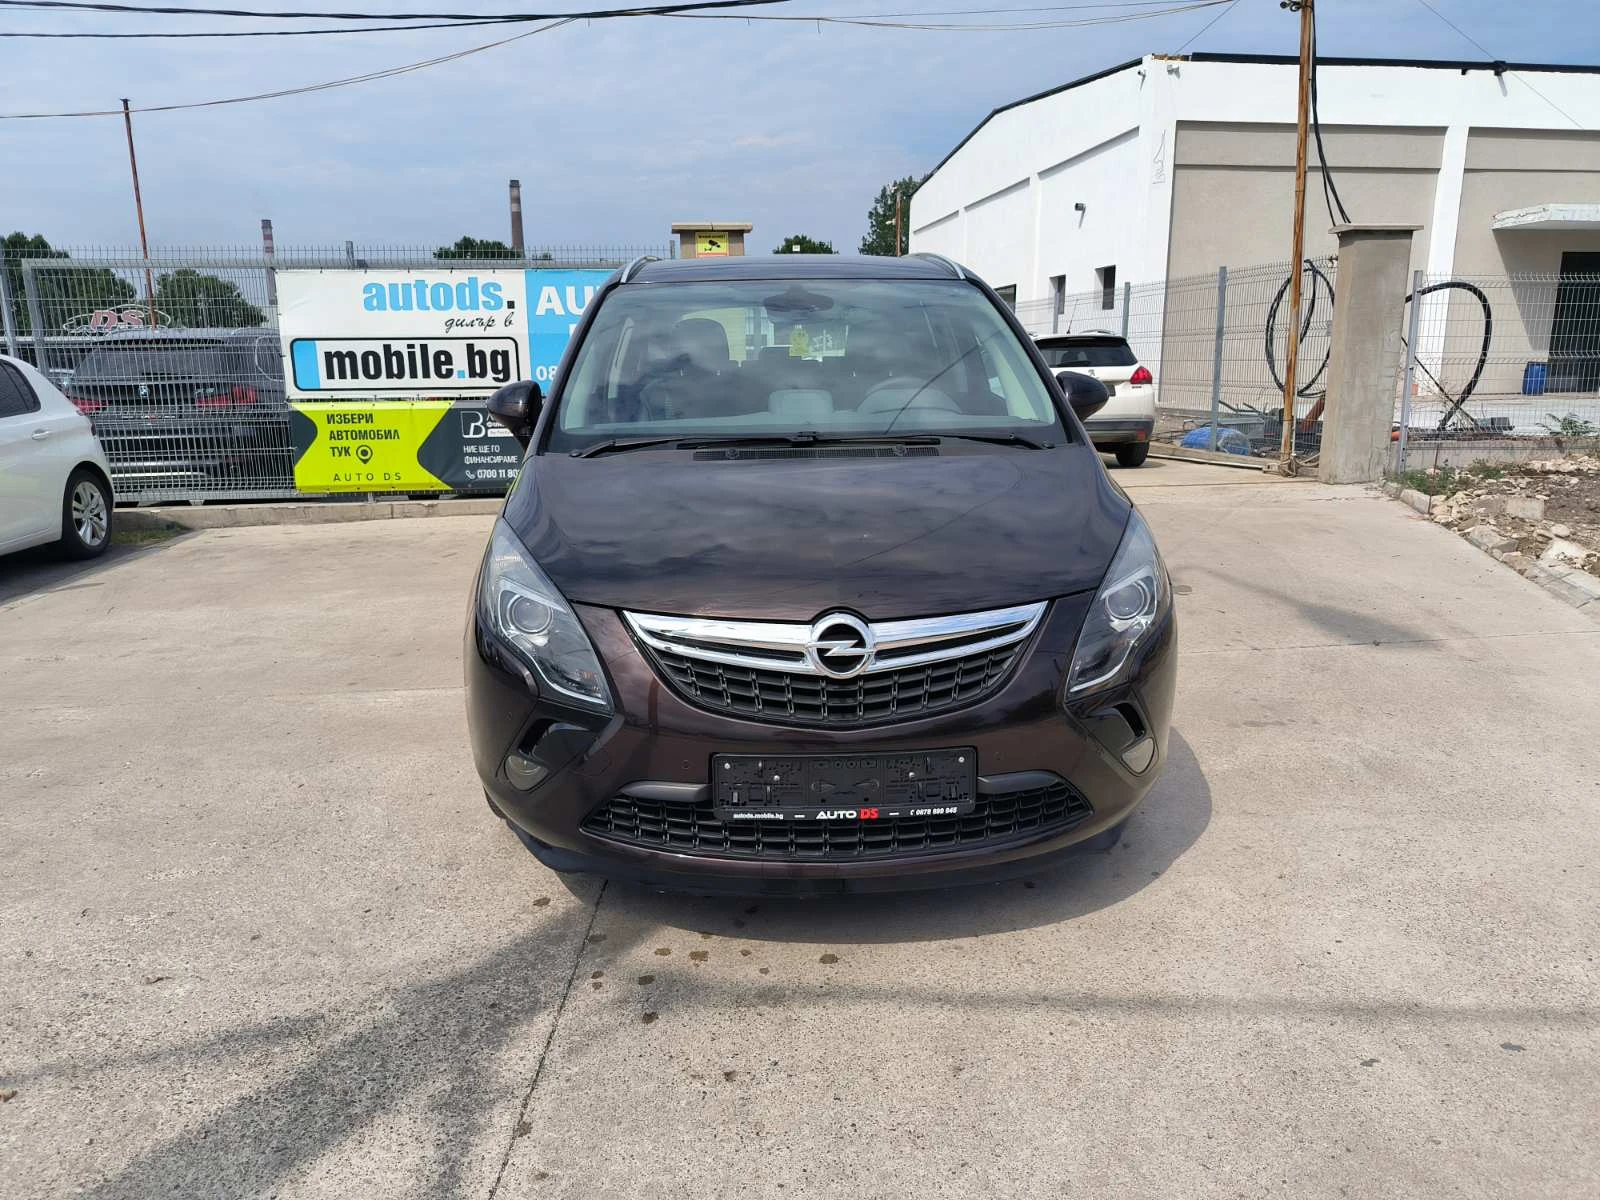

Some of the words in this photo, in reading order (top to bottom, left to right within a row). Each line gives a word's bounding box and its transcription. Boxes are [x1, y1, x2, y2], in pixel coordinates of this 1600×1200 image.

[535, 285, 601, 316] AU
[444, 316, 496, 334] дилър
[324, 343, 512, 383] mobile.bg
[326, 413, 374, 425] ИЗБЕРИ
[329, 429, 400, 441] АВТОМОБИЛ
[329, 446, 351, 457] ТУК
[333, 472, 374, 482] AUTO
[383, 472, 402, 481] DS
[476, 468, 497, 479] 0700
[816, 810, 857, 820] AUTO
[859, 807, 880, 819] DS
